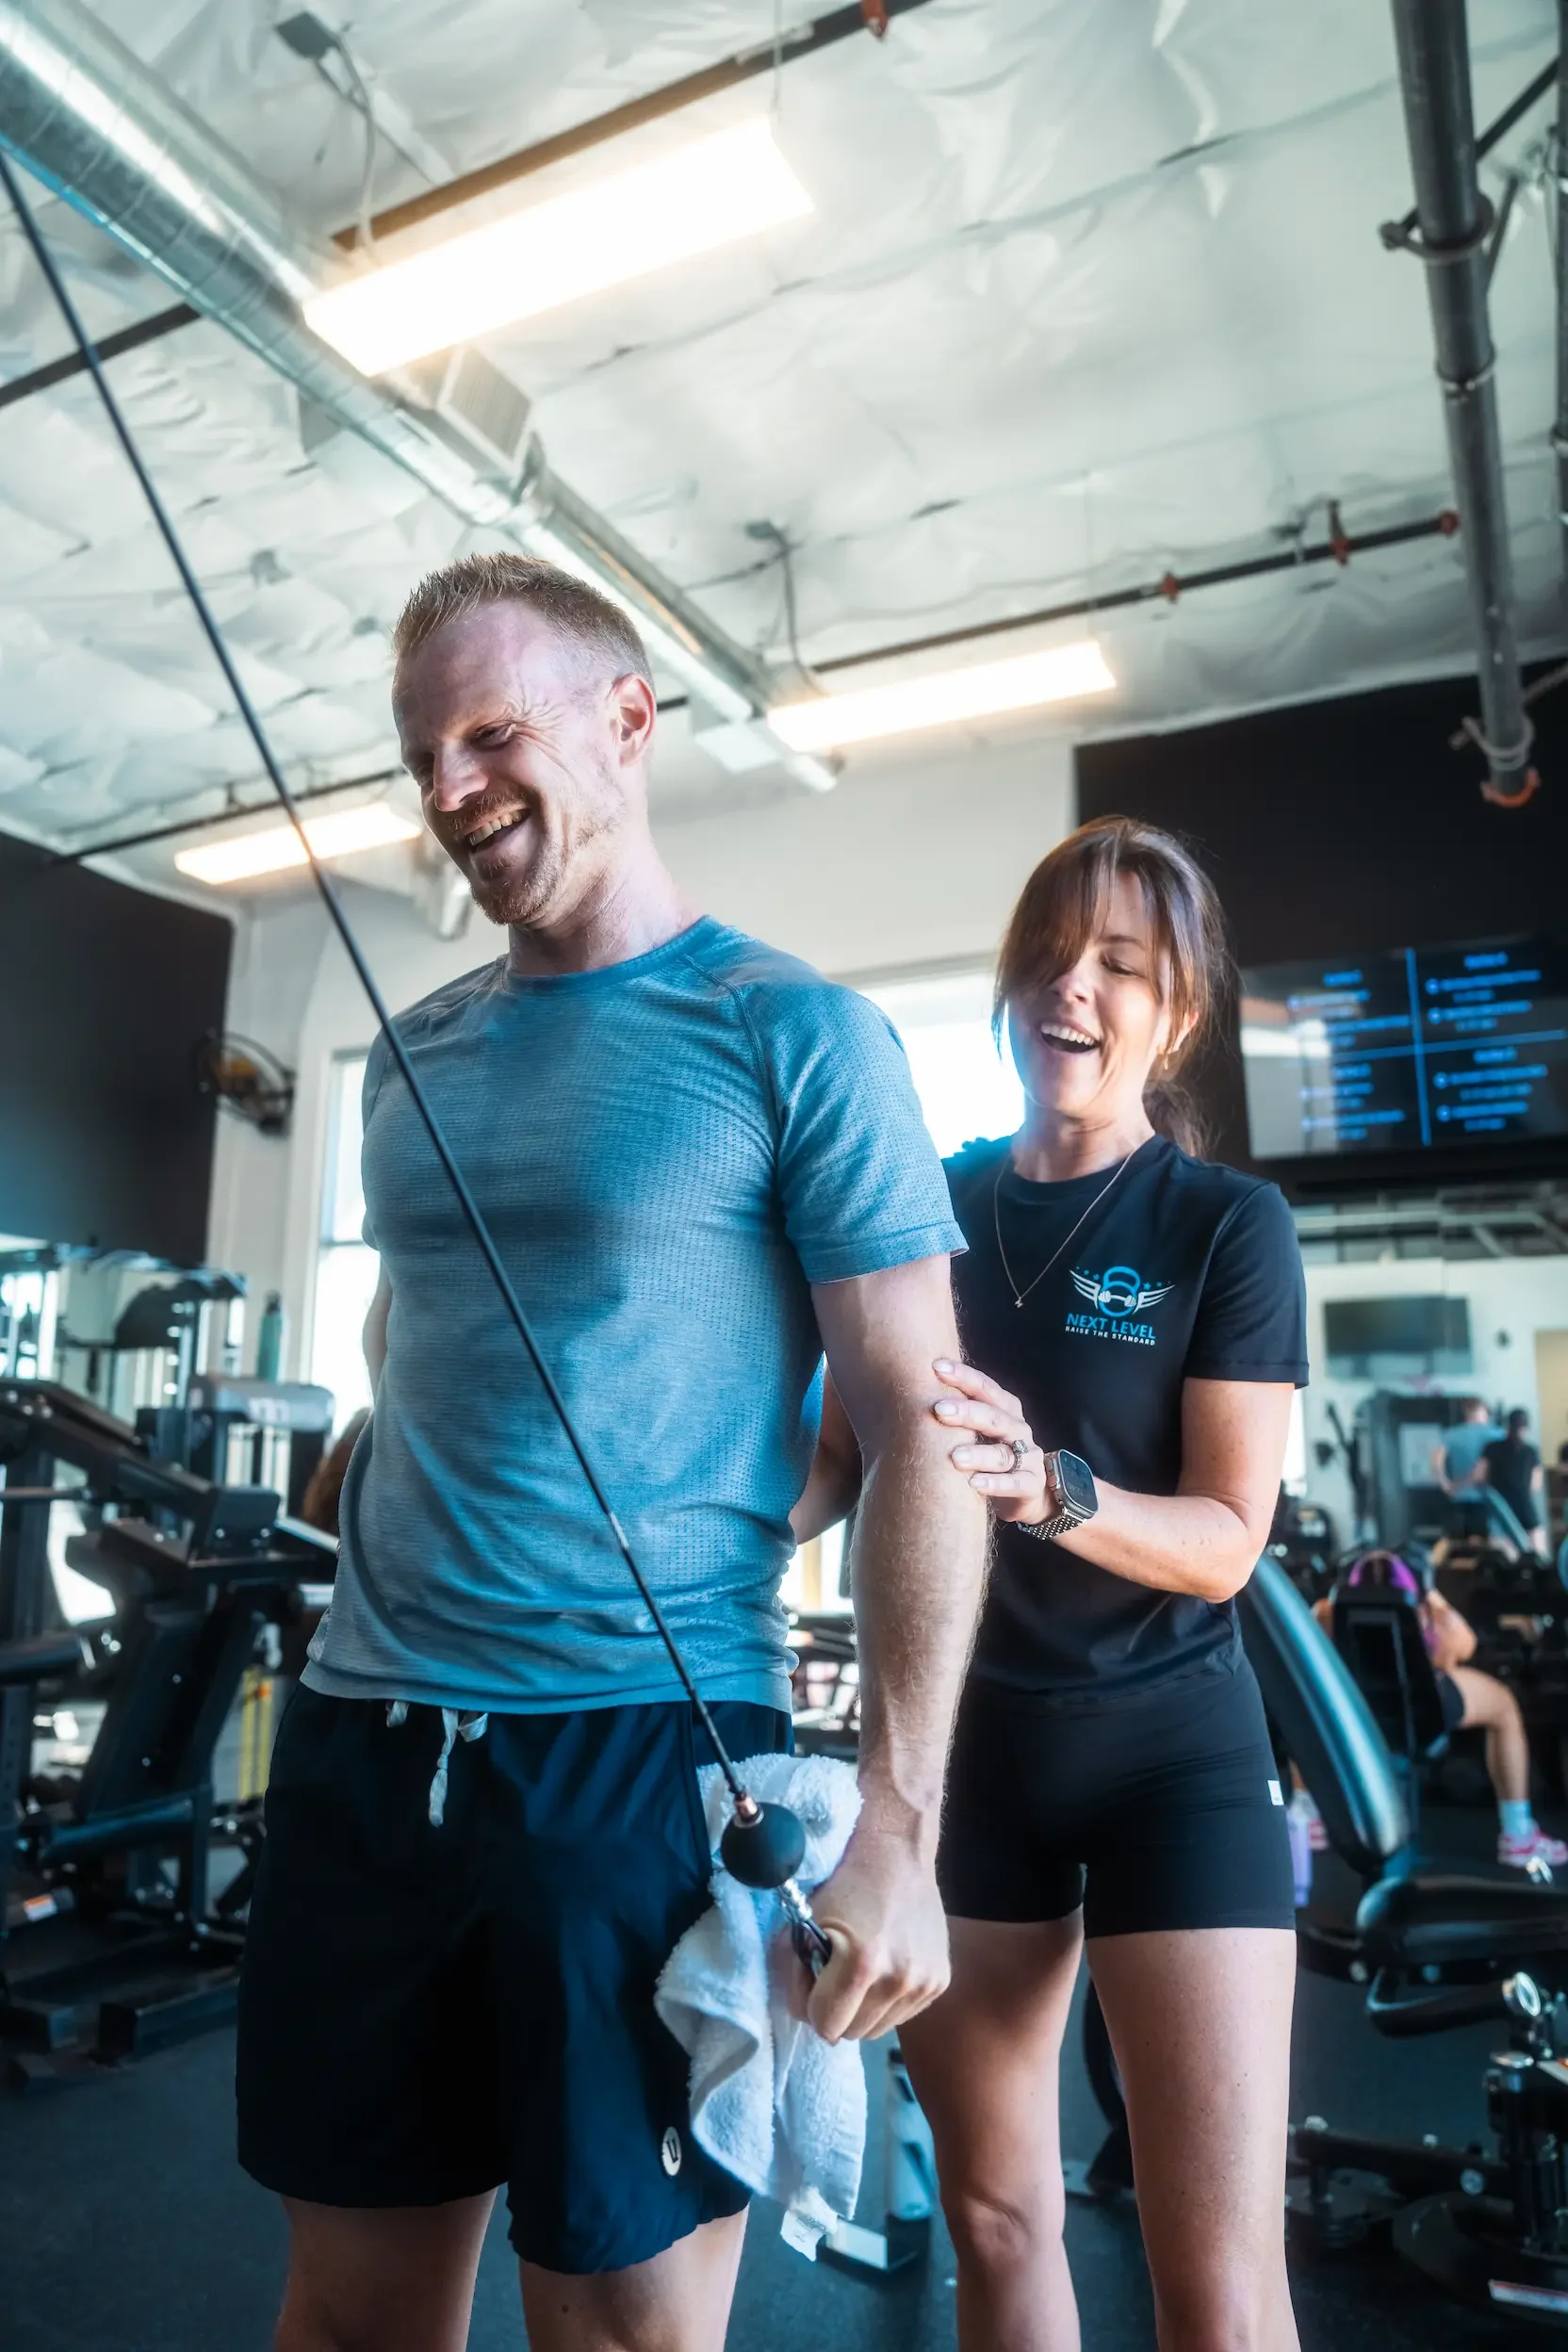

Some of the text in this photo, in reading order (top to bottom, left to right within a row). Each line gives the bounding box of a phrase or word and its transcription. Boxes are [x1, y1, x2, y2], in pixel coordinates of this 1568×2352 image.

[1065, 1326, 1155, 1346] RAISE THE STANDARD
[1066, 1313, 1156, 1339] NEXT LEVEL
